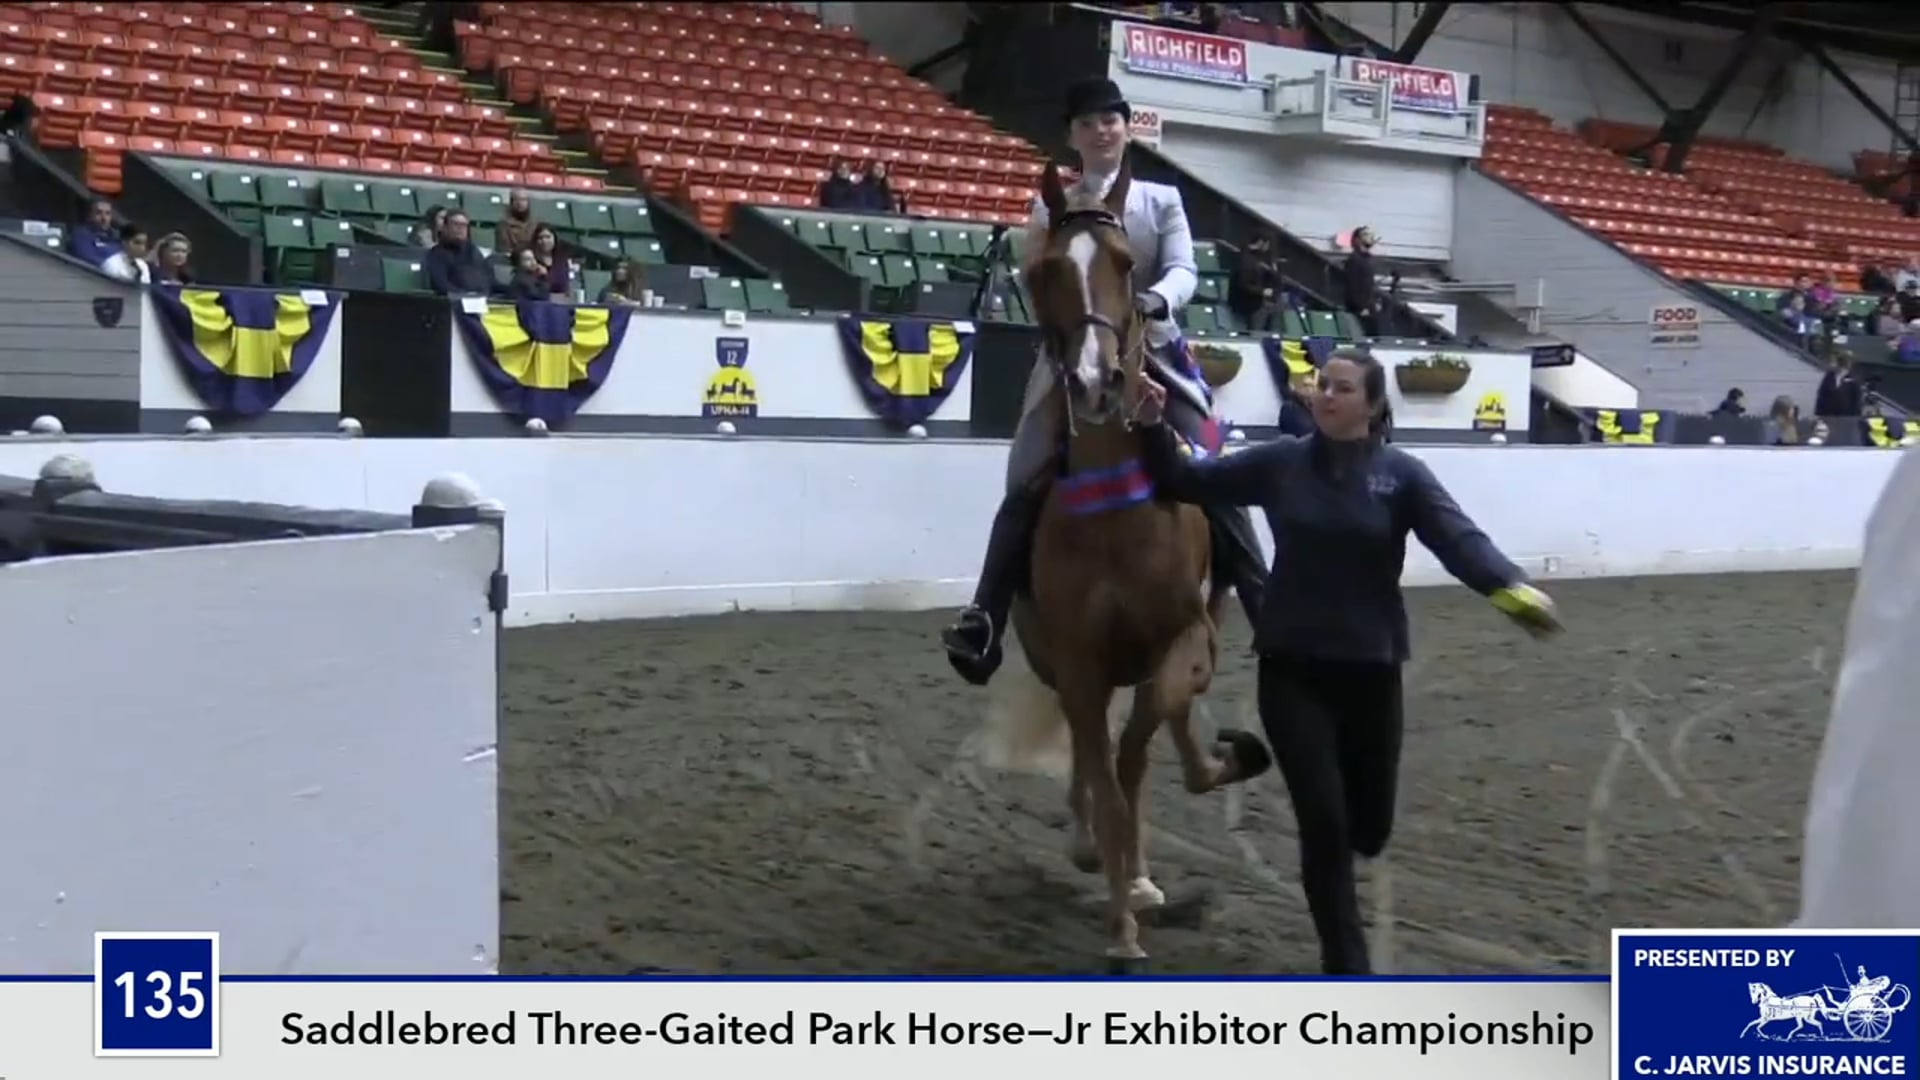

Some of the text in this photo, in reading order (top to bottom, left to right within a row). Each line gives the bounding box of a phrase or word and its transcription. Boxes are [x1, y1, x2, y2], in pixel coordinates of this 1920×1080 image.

[1131, 30, 1242, 66] RICHFIELD
[1131, 110, 1158, 127] OOD
[1653, 307, 1697, 322] FOOD
[727, 350, 738, 365] 12
